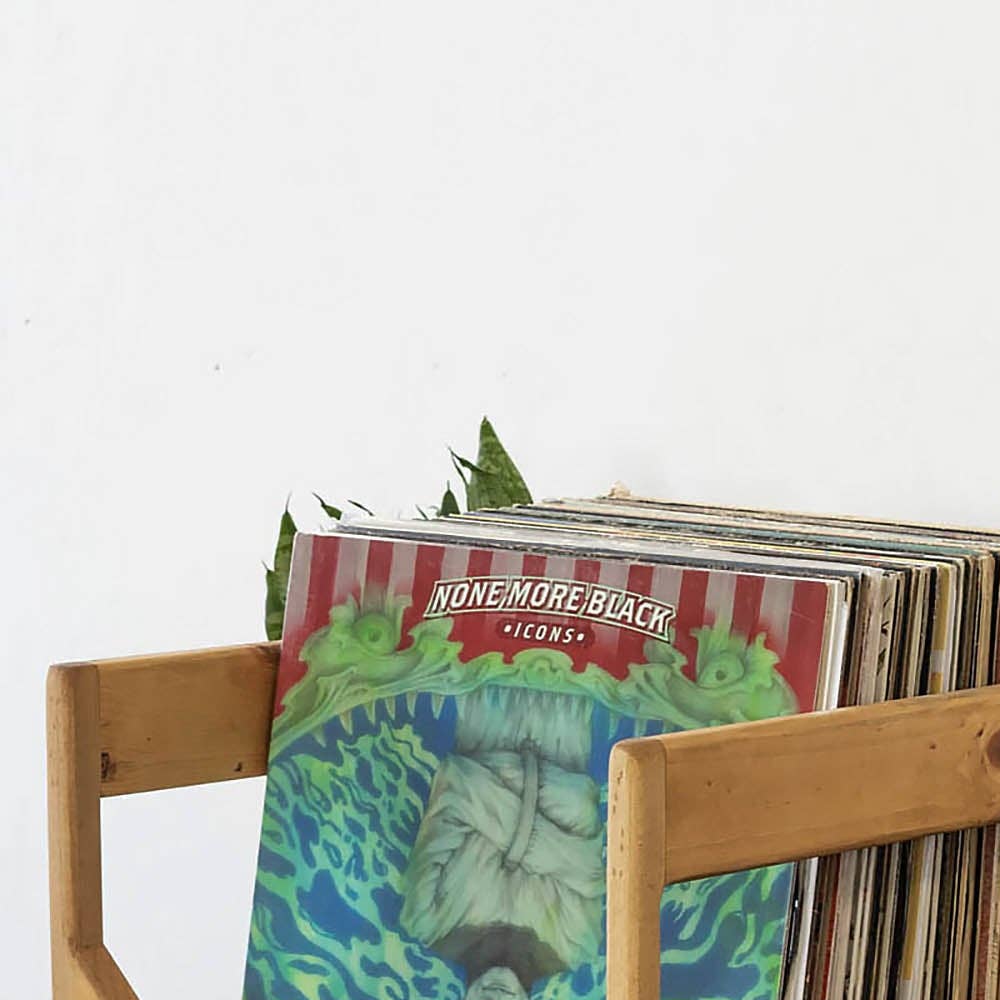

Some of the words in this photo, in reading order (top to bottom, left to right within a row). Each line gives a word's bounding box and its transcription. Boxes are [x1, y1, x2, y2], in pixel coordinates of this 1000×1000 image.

[432, 581, 502, 611] NONE
[504, 581, 585, 612] MORE
[587, 588, 672, 634] BLACK
